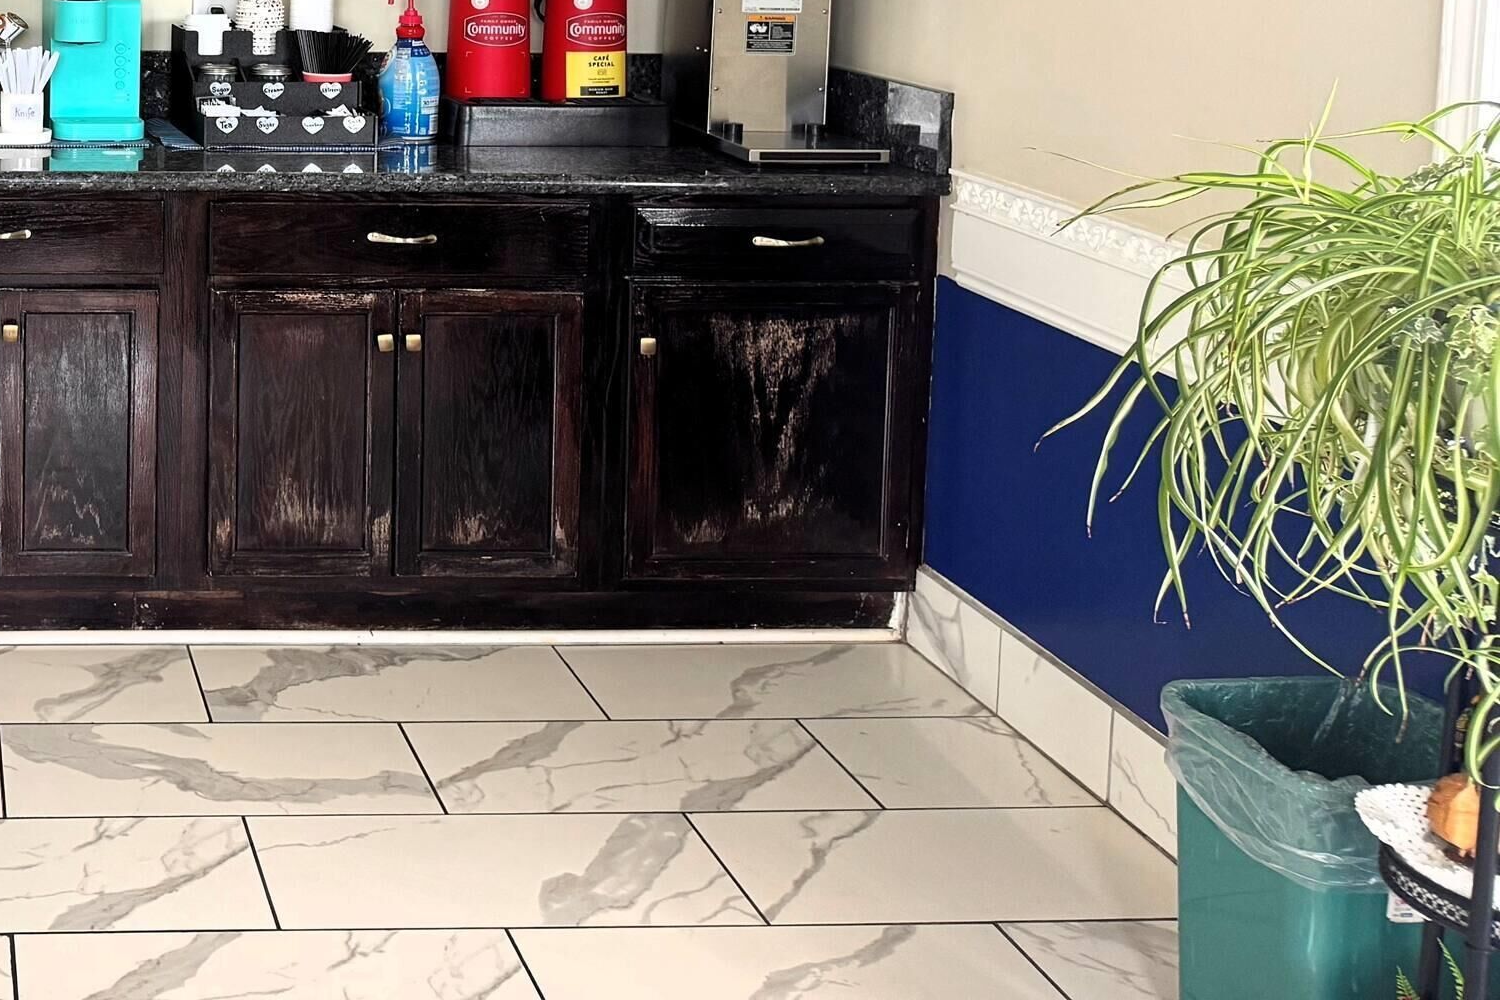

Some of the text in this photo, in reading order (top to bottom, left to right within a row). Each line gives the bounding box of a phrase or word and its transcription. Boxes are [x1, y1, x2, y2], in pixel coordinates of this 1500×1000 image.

[467, 22, 525, 37] Community
[569, 22, 625, 37] Community
[211, 86, 230, 97] Sugar
[15, 106, 35, 120] Knife
[220, 121, 233, 129] Tea
[258, 120, 276, 130] Sugar
